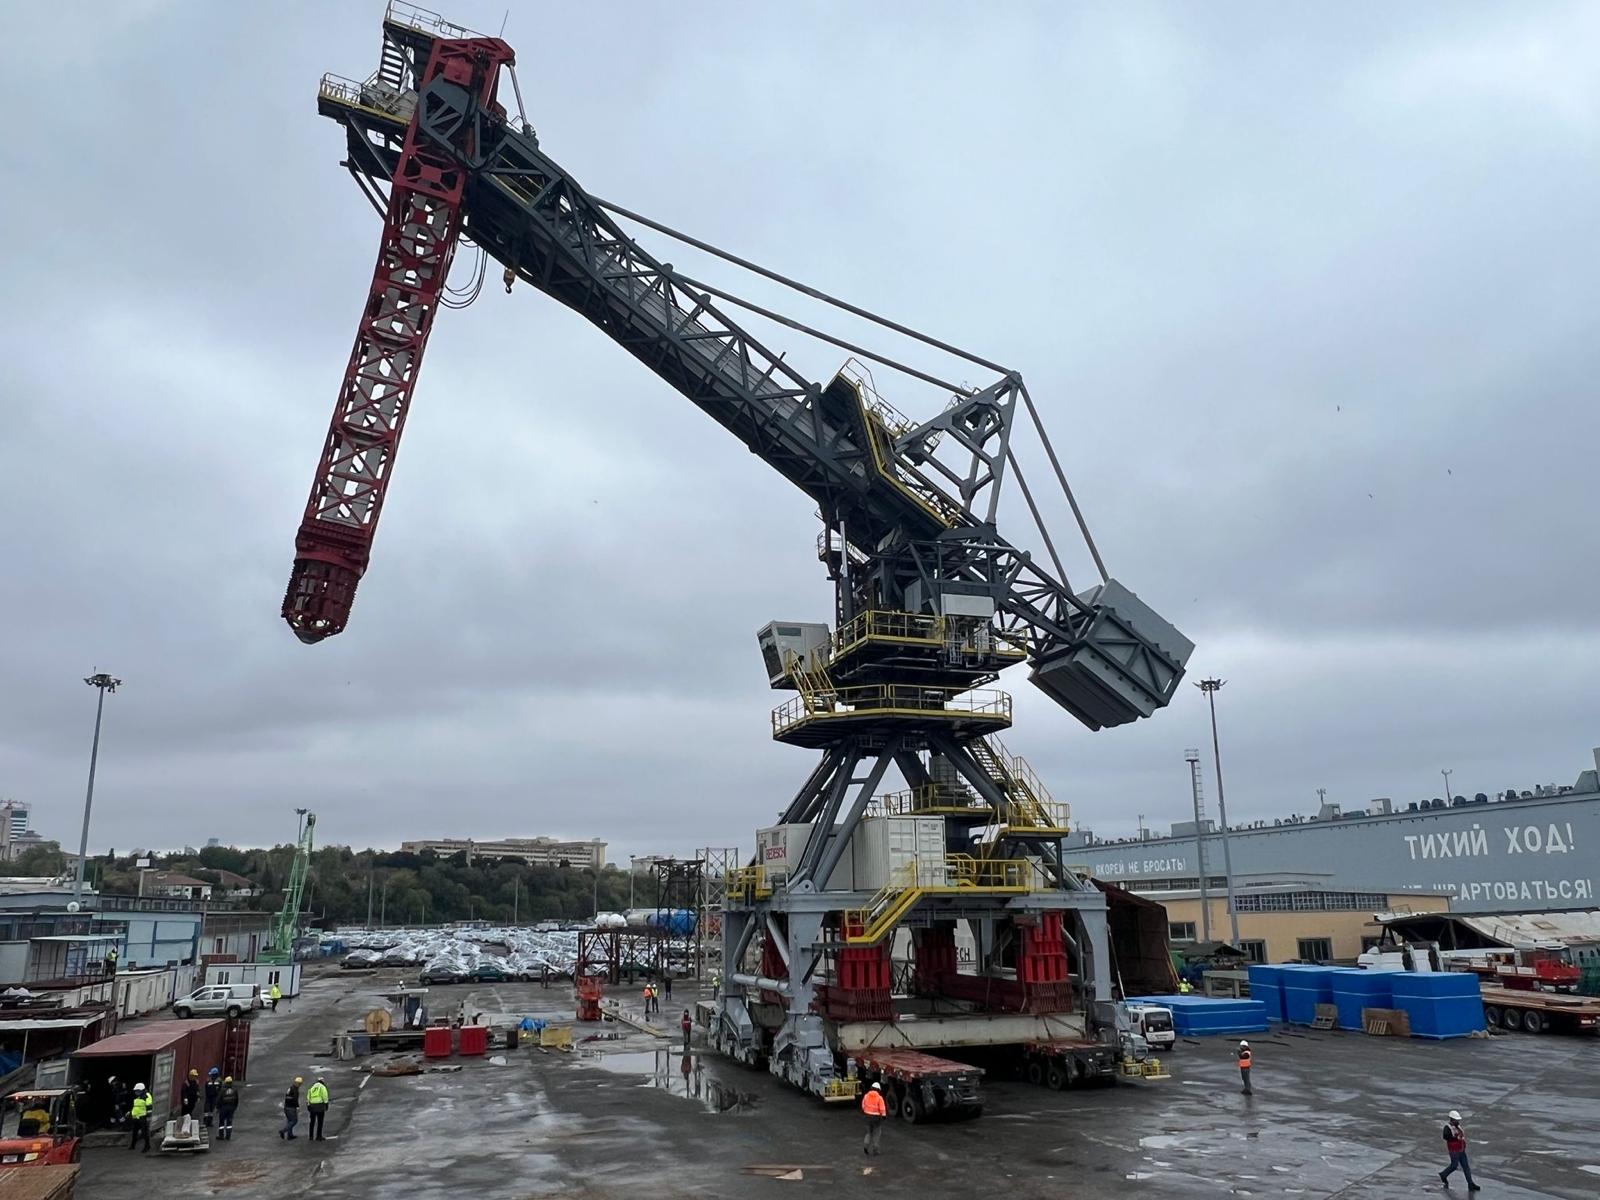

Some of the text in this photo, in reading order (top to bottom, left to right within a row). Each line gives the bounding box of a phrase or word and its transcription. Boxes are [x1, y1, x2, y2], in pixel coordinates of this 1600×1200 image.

[1404, 822, 1575, 860] ТИХИЙ ХОД!
[1128, 861, 1140, 873] НЕ
[1143, 858, 1186, 872] БРОСАТЬ!
